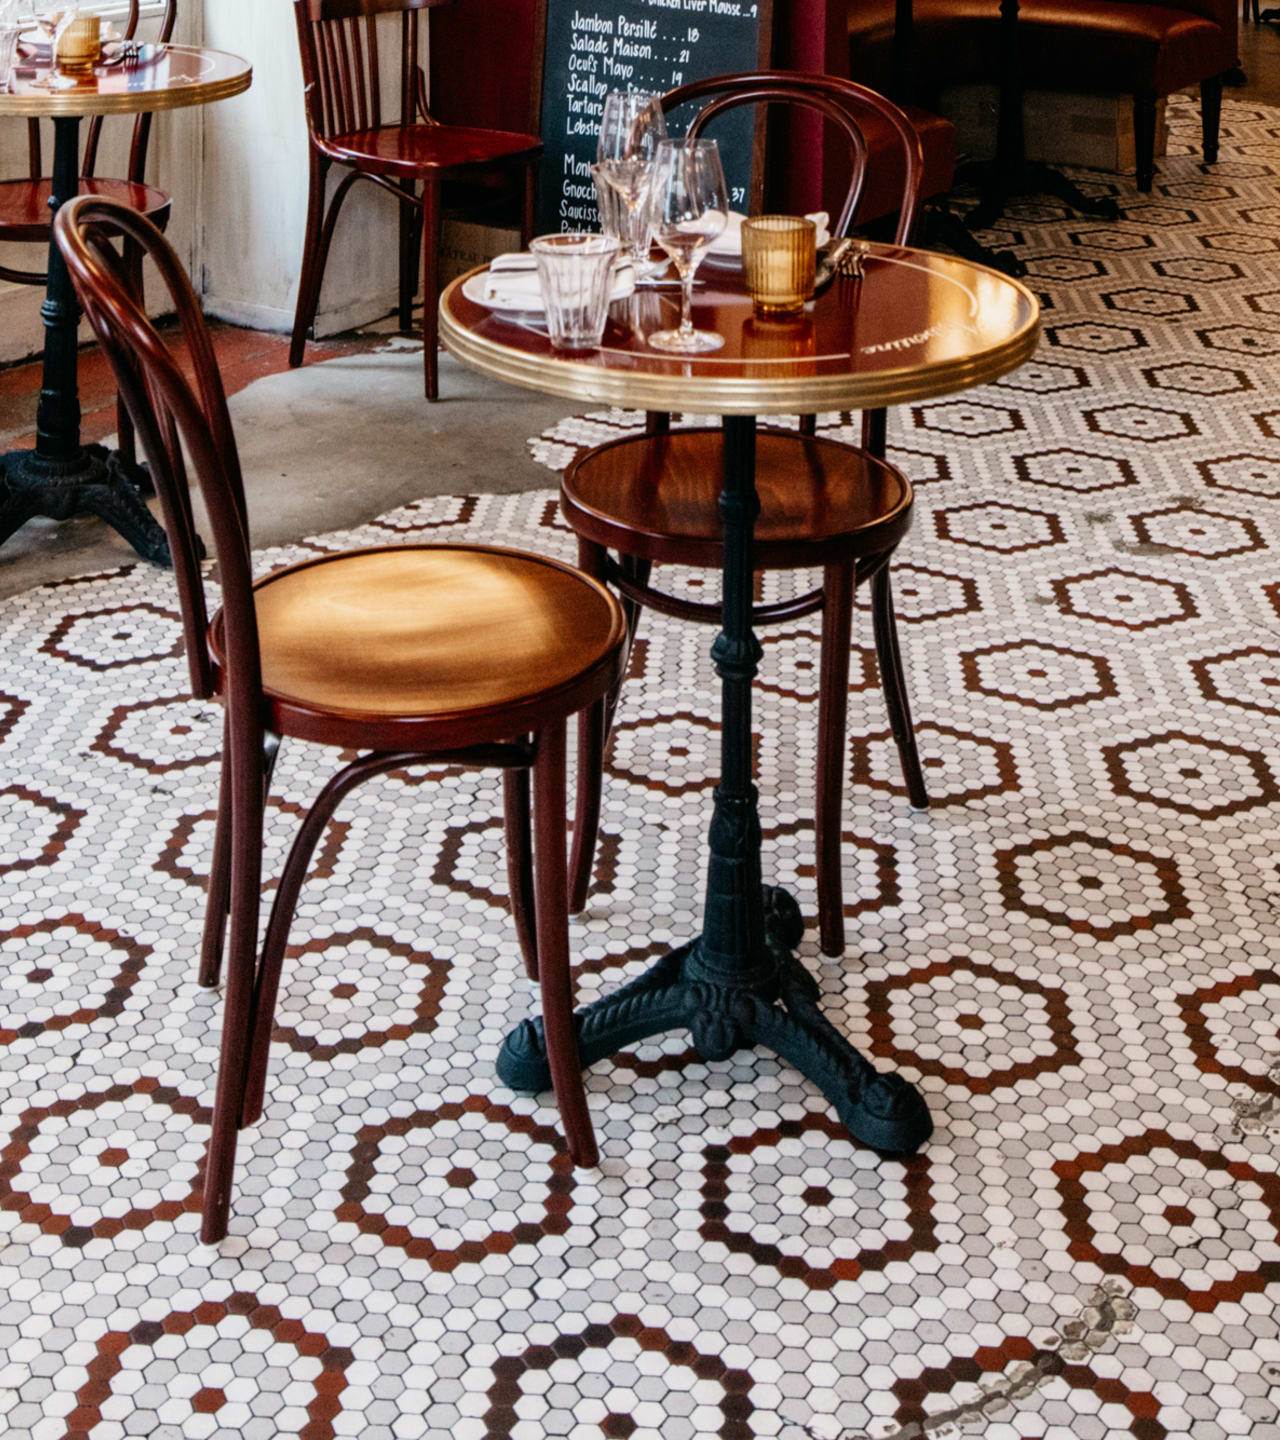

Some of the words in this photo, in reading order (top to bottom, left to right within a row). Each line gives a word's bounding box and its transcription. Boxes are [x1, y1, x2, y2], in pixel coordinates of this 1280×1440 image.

[571, 10, 613, 34] Jambon
[618, 15, 658, 39] Persillé
[688, 28, 700, 43] 18
[570, 33, 609, 54] Salade
[613, 37, 652, 60] Maison
[679, 50, 690, 63] 21
[568, 54, 598, 74] Oeufs
[603, 56, 634, 80] Mayo
[672, 71, 683, 86] 19
[568, 73, 608, 100] Scallop
